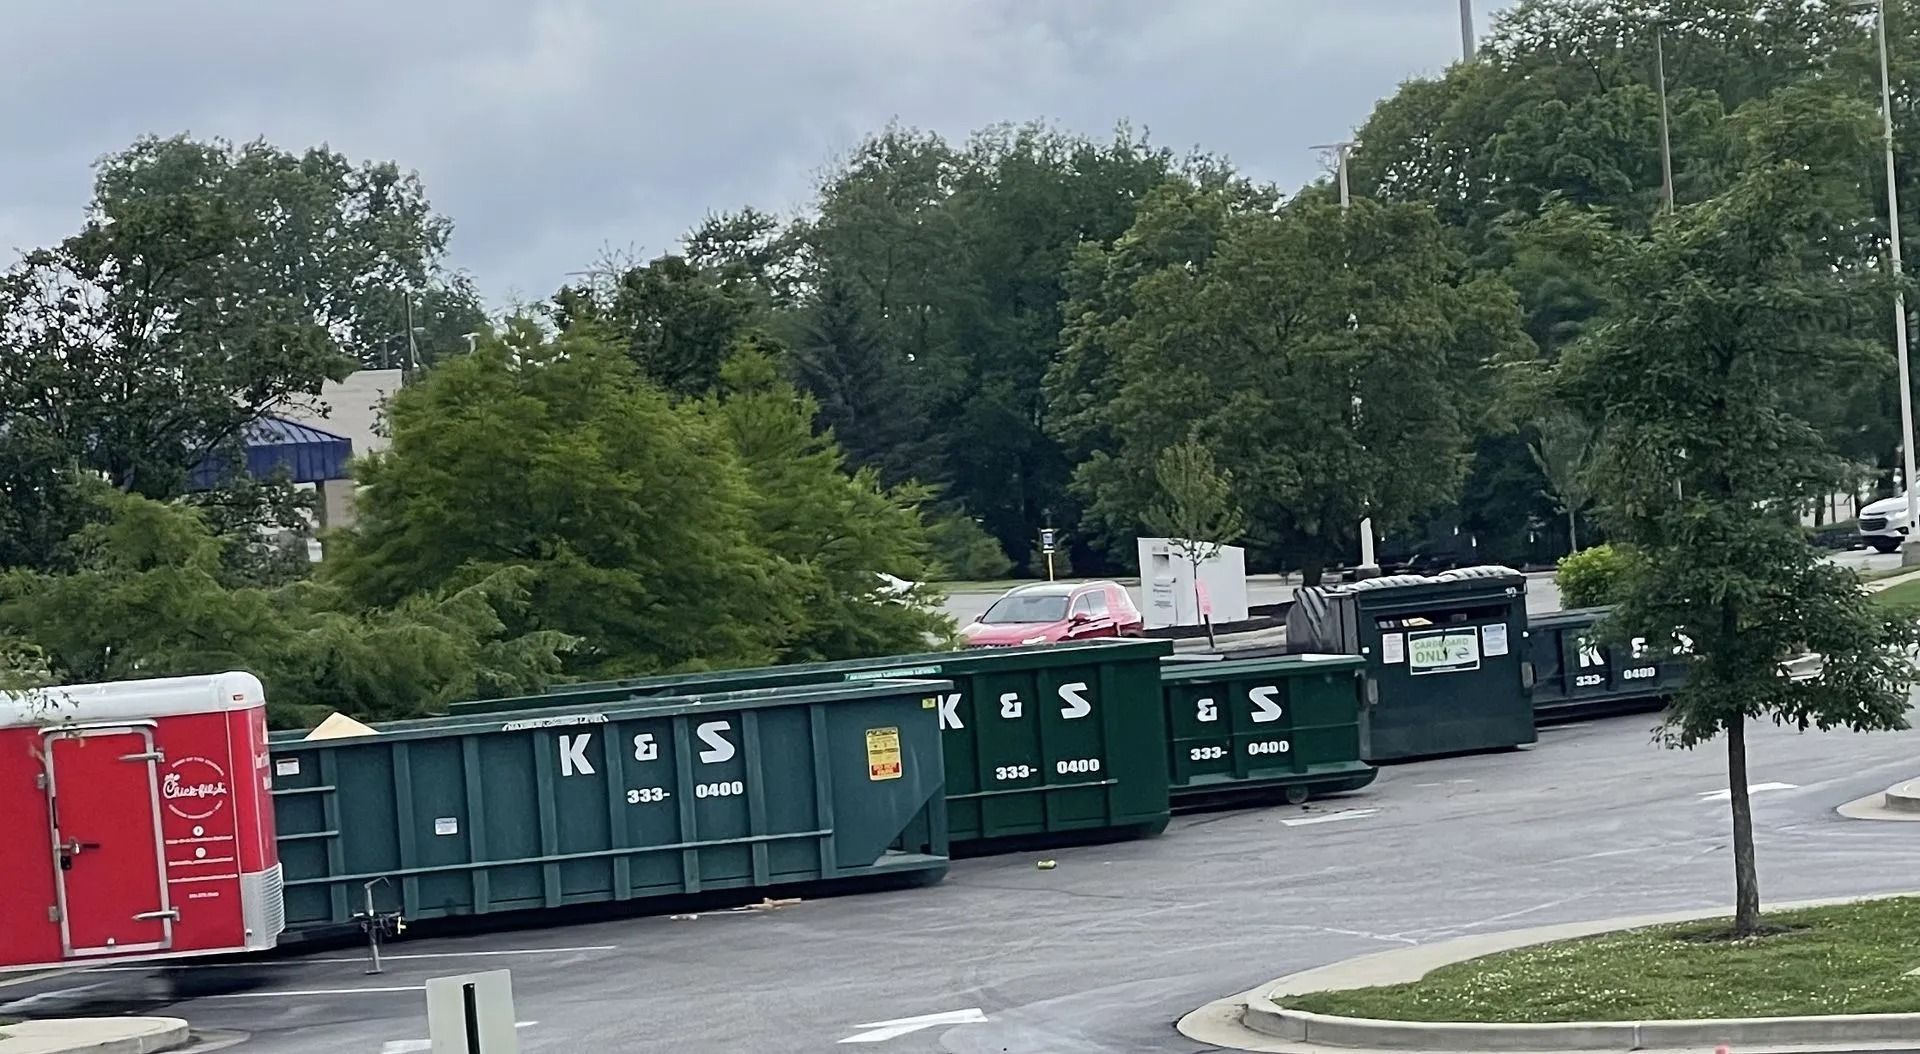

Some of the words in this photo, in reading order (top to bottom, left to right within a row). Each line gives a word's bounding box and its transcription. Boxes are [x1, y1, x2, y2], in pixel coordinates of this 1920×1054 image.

[1578, 637, 1604, 667] K
[1576, 674, 1605, 686] 333-
[1624, 667, 1656, 679] 0400
[938, 693, 964, 730] K
[1000, 692, 1022, 719] &
[1058, 682, 1091, 719] S
[1197, 698, 1217, 722] &
[1249, 686, 1282, 722] S
[559, 733, 595, 776] K
[634, 733, 658, 761] &
[696, 720, 735, 764] S
[1190, 746, 1228, 760] 333-
[1248, 741, 1289, 755] 0400
[996, 765, 1037, 780] 333-
[1057, 759, 1099, 774] 0400
[627, 787, 670, 804] 333-
[696, 781, 743, 798] 0400
